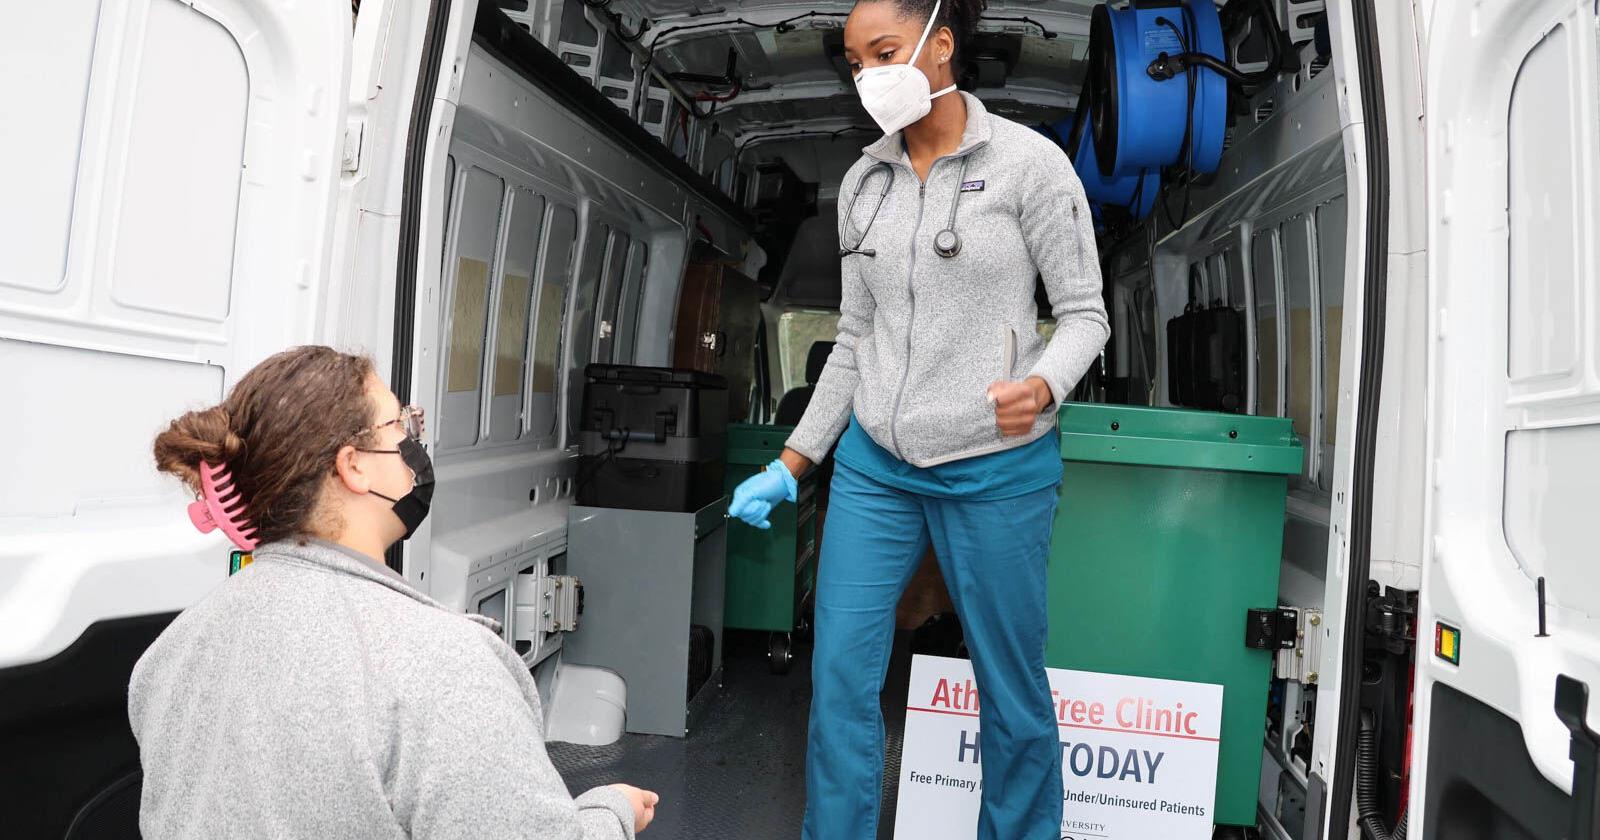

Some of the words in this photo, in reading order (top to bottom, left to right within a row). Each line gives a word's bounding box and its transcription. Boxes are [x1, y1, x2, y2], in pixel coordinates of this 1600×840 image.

[930, 678, 981, 712] Ath
[1115, 697, 1199, 735] Clinic
[1059, 741, 1165, 785] TODAY
[910, 770, 933, 785] Free
[935, 774, 977, 793] Primary
[1160, 800, 1206, 817] Patients
[1061, 820, 1106, 832] IVERSITY
